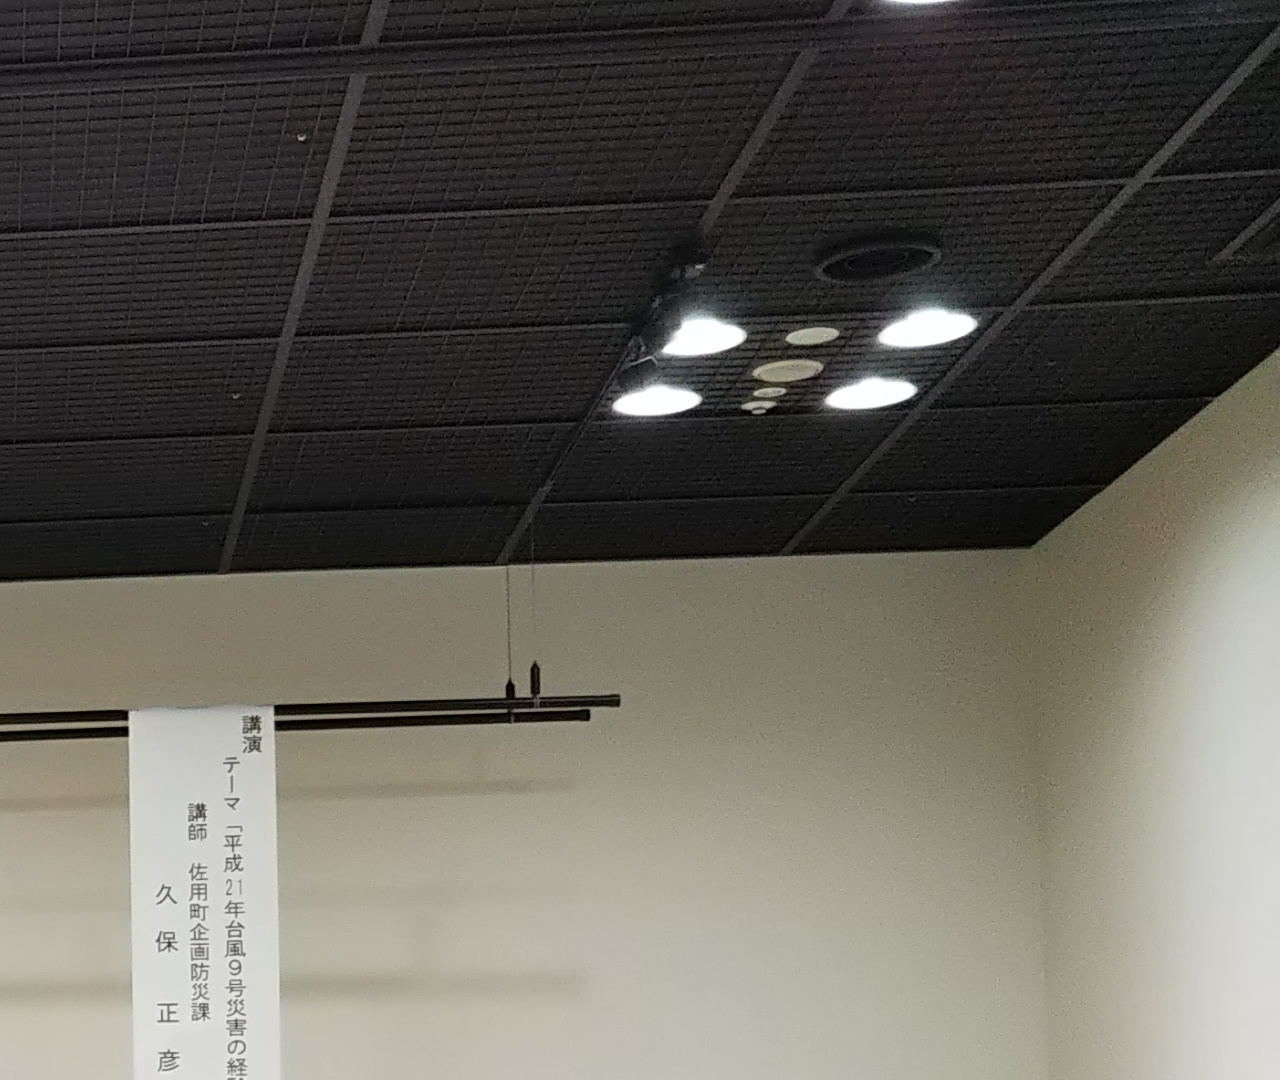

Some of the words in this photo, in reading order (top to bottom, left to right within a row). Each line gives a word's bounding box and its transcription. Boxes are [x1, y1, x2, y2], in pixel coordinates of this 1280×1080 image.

[242, 714, 262, 754] 講演
[187, 802, 208, 841] 講師
[188, 862, 211, 1022] 佐用町企画防災課
